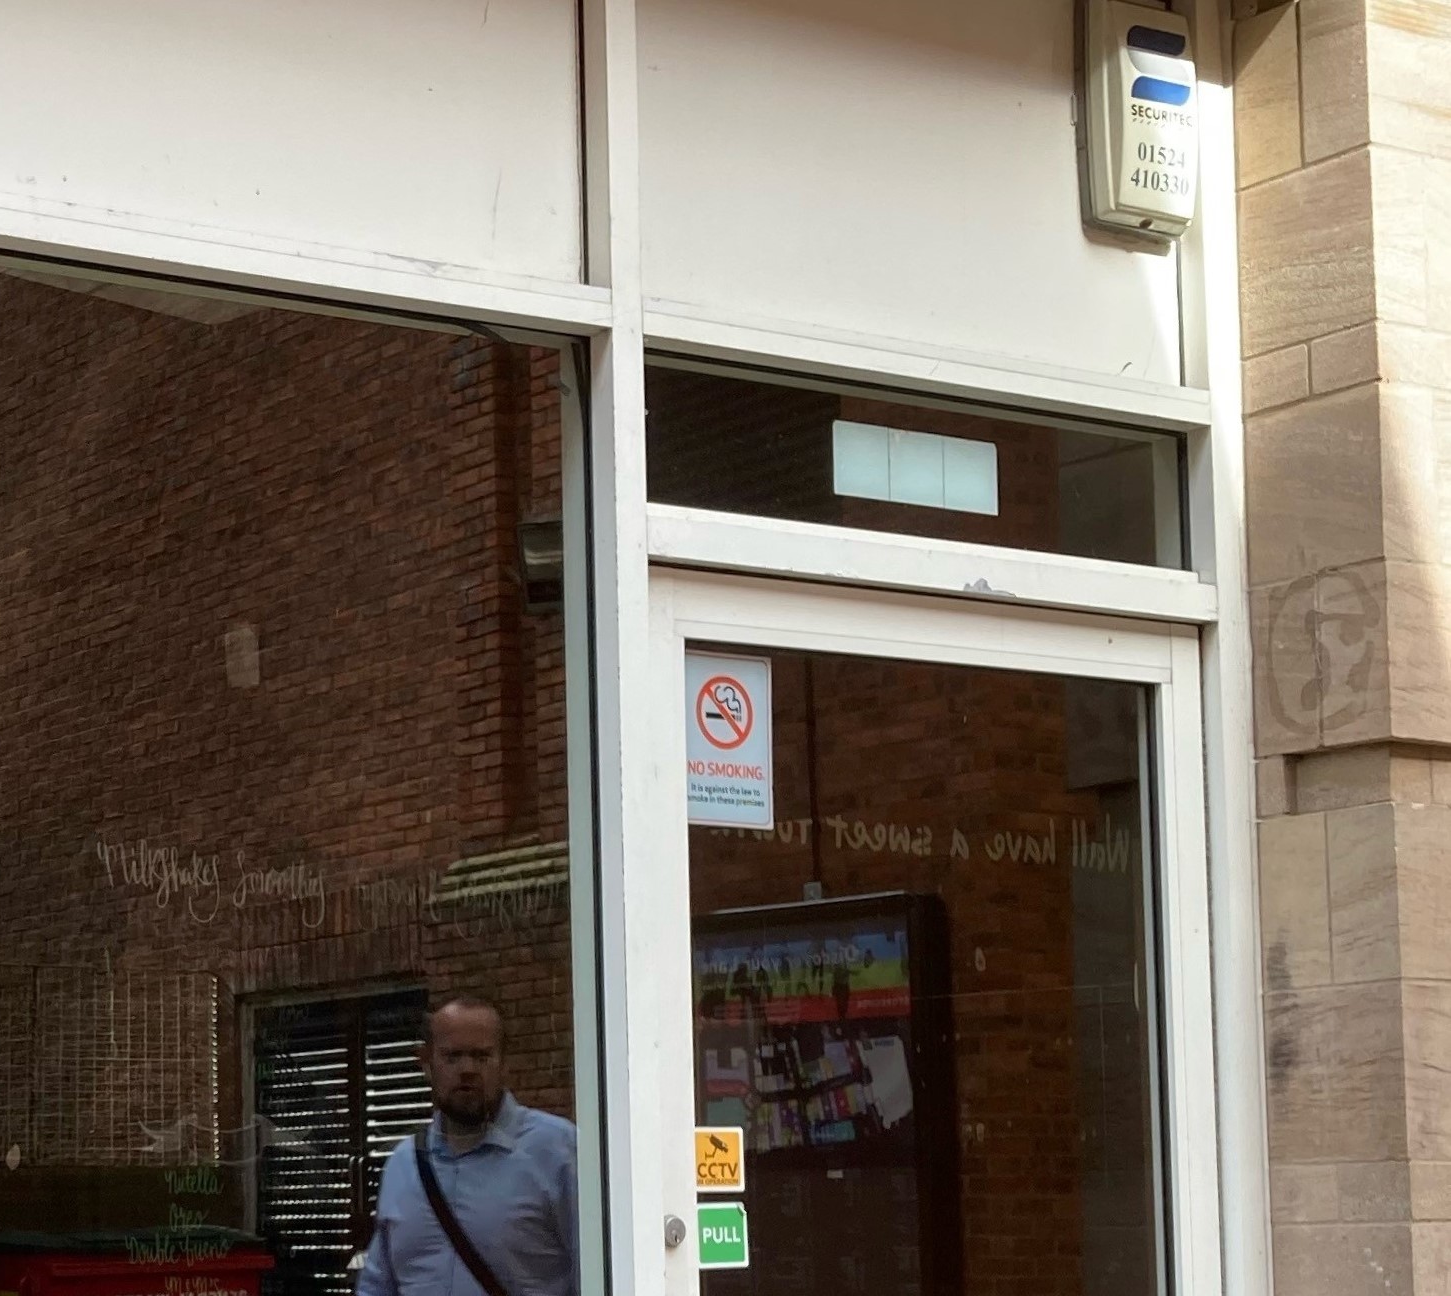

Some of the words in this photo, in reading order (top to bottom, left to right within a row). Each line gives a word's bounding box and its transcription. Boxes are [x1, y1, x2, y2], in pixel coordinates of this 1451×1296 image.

[1131, 104, 1193, 127] SECURITEC
[1137, 141, 1185, 168] 01524
[1130, 167, 1190, 196] 410330
[687, 759, 705, 776] NO
[697, 1162, 738, 1178] CCTV
[702, 1226, 741, 1244] PULL
